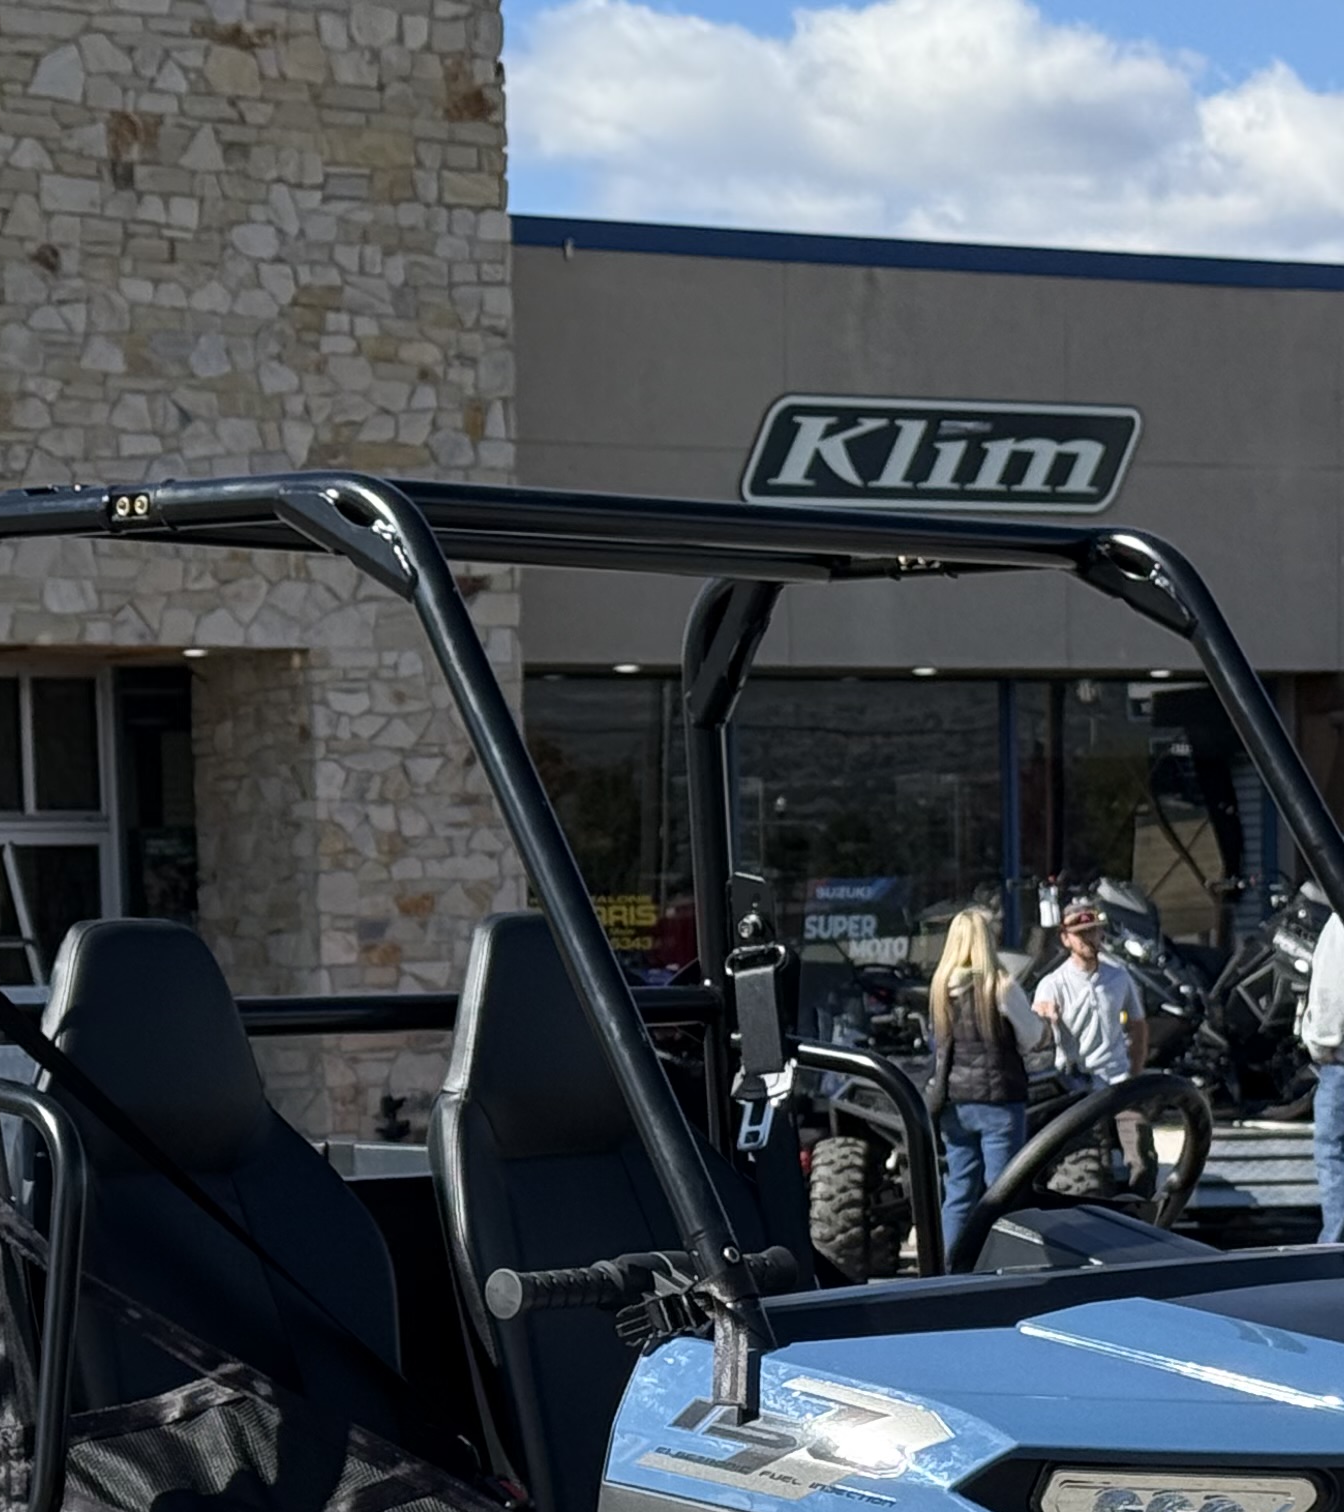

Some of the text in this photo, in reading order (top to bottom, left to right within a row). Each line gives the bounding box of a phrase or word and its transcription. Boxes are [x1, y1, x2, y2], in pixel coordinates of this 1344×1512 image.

[766, 415, 1106, 494] Klim
[815, 886, 874, 899] SUZUKI
[596, 904, 658, 927] ARIS
[804, 914, 877, 939] SUPER
[849, 935, 909, 962] MOTO
[759, 1470, 803, 1487] FUEL
[809, 1482, 898, 1507] INJECTION
